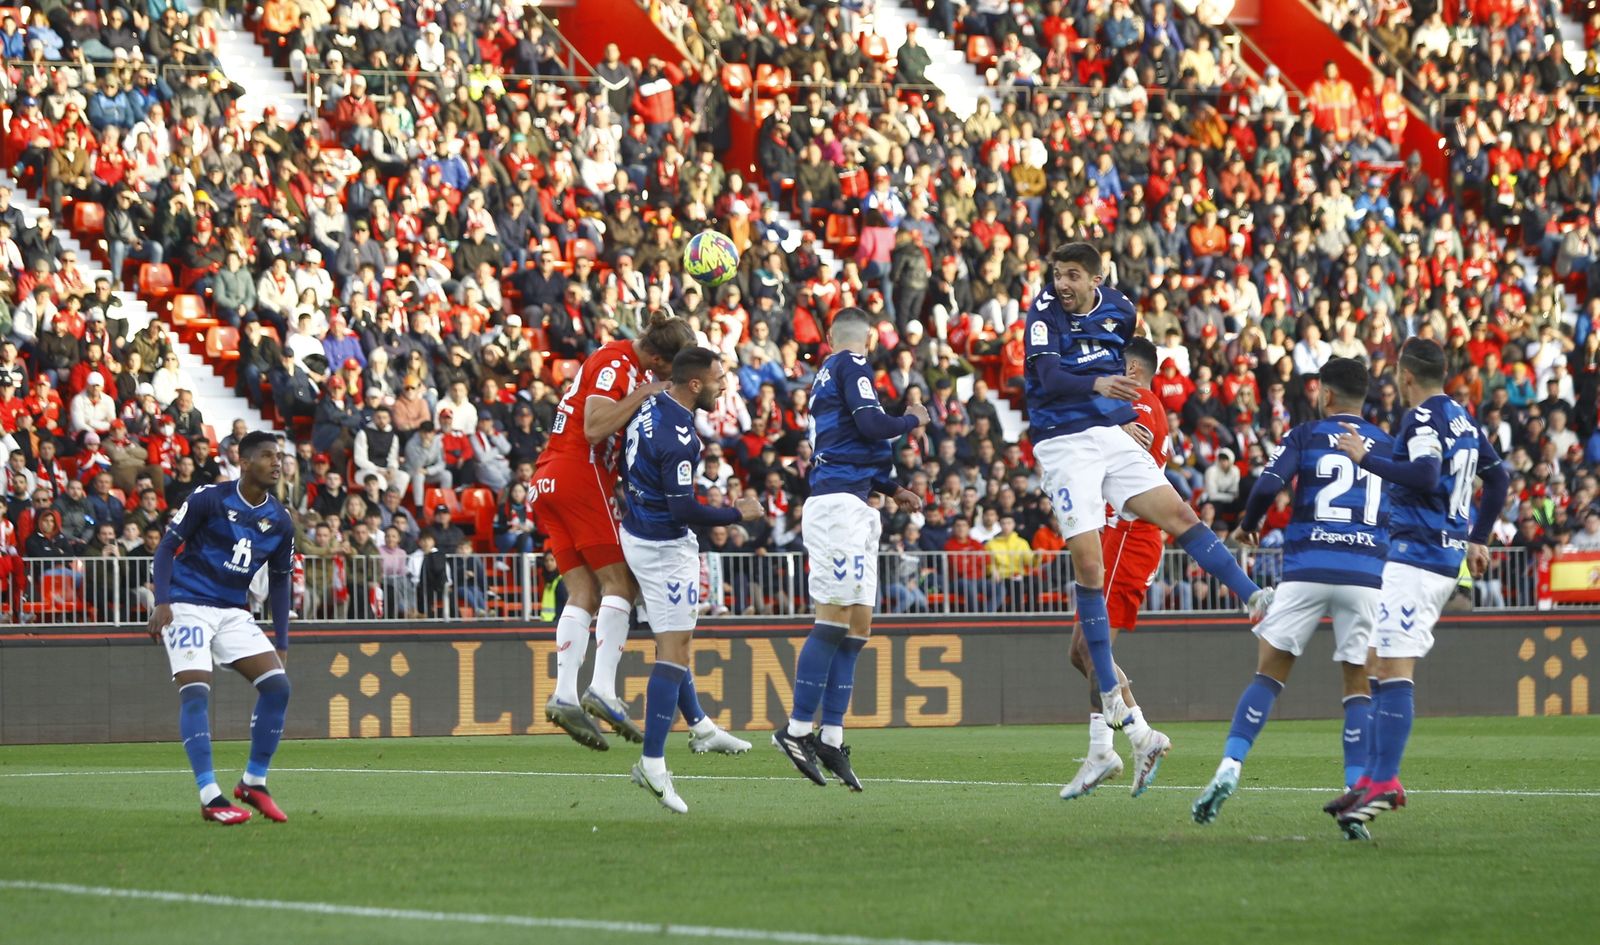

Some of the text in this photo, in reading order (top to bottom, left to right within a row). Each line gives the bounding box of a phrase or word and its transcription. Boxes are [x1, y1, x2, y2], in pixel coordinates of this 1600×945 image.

[1077, 349, 1110, 364] network
[1058, 488, 1073, 512] 3
[1315, 453, 1382, 526] 21
[1310, 529, 1377, 547] LegacyFX
[853, 555, 865, 580] 5
[687, 581, 698, 606] 6
[178, 625, 204, 649] 20
